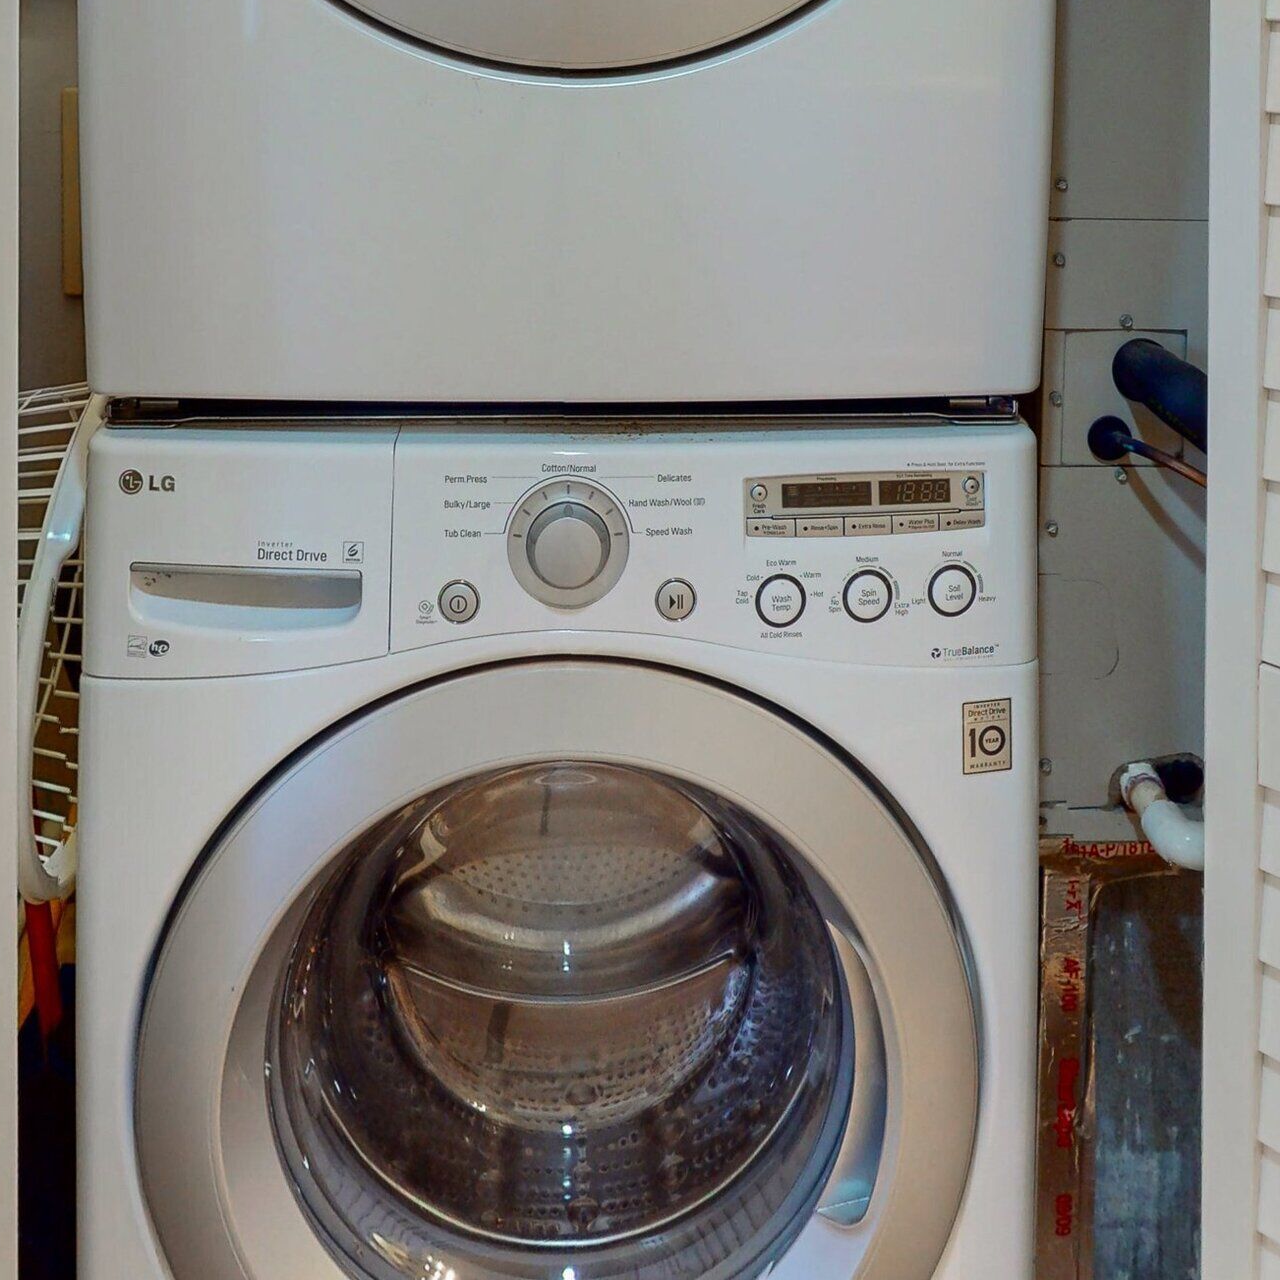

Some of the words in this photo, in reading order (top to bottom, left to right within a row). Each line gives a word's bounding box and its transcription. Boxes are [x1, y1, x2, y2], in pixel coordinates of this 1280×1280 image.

[541, 464, 597, 473] Cotton/Normal
[444, 475, 464, 484] Perm
[466, 475, 488, 484] Press
[657, 474, 692, 482] Delicates
[149, 475, 176, 492] LG
[444, 500, 491, 510] Bulky/Large
[628, 499, 648, 508] Hand
[650, 498, 692, 508] Wash/Wool
[444, 529, 459, 538] Tub
[460, 529, 482, 538] Clean
[645, 528, 670, 537] Speed
[670, 527, 693, 536] Wash
[257, 540, 294, 548] Inverter
[257, 548, 294, 561] Direct
[296, 549, 327, 563] Drive
[942, 550, 963, 558] Normal
[766, 559, 777, 567] Eco
[778, 559, 797, 567] Warm
[746, 574, 760, 582] Cold
[861, 589, 877, 598] Spin
[947, 585, 961, 593] Soil
[737, 590, 748, 598] Tap
[945, 593, 964, 601] Level
[735, 597, 749, 605] Cold
[771, 595, 792, 604] Wash
[858, 598, 881, 607] Speed
[911, 597, 926, 606] Light
[772, 604, 792, 612] Temp
[828, 606, 842, 614] Spin
[769, 631, 782, 639] Cold
[783, 631, 803, 639] Rinses
[968, 709, 988, 717] Direct
[989, 707, 1007, 715] Drive
[969, 725, 1006, 758] 10
